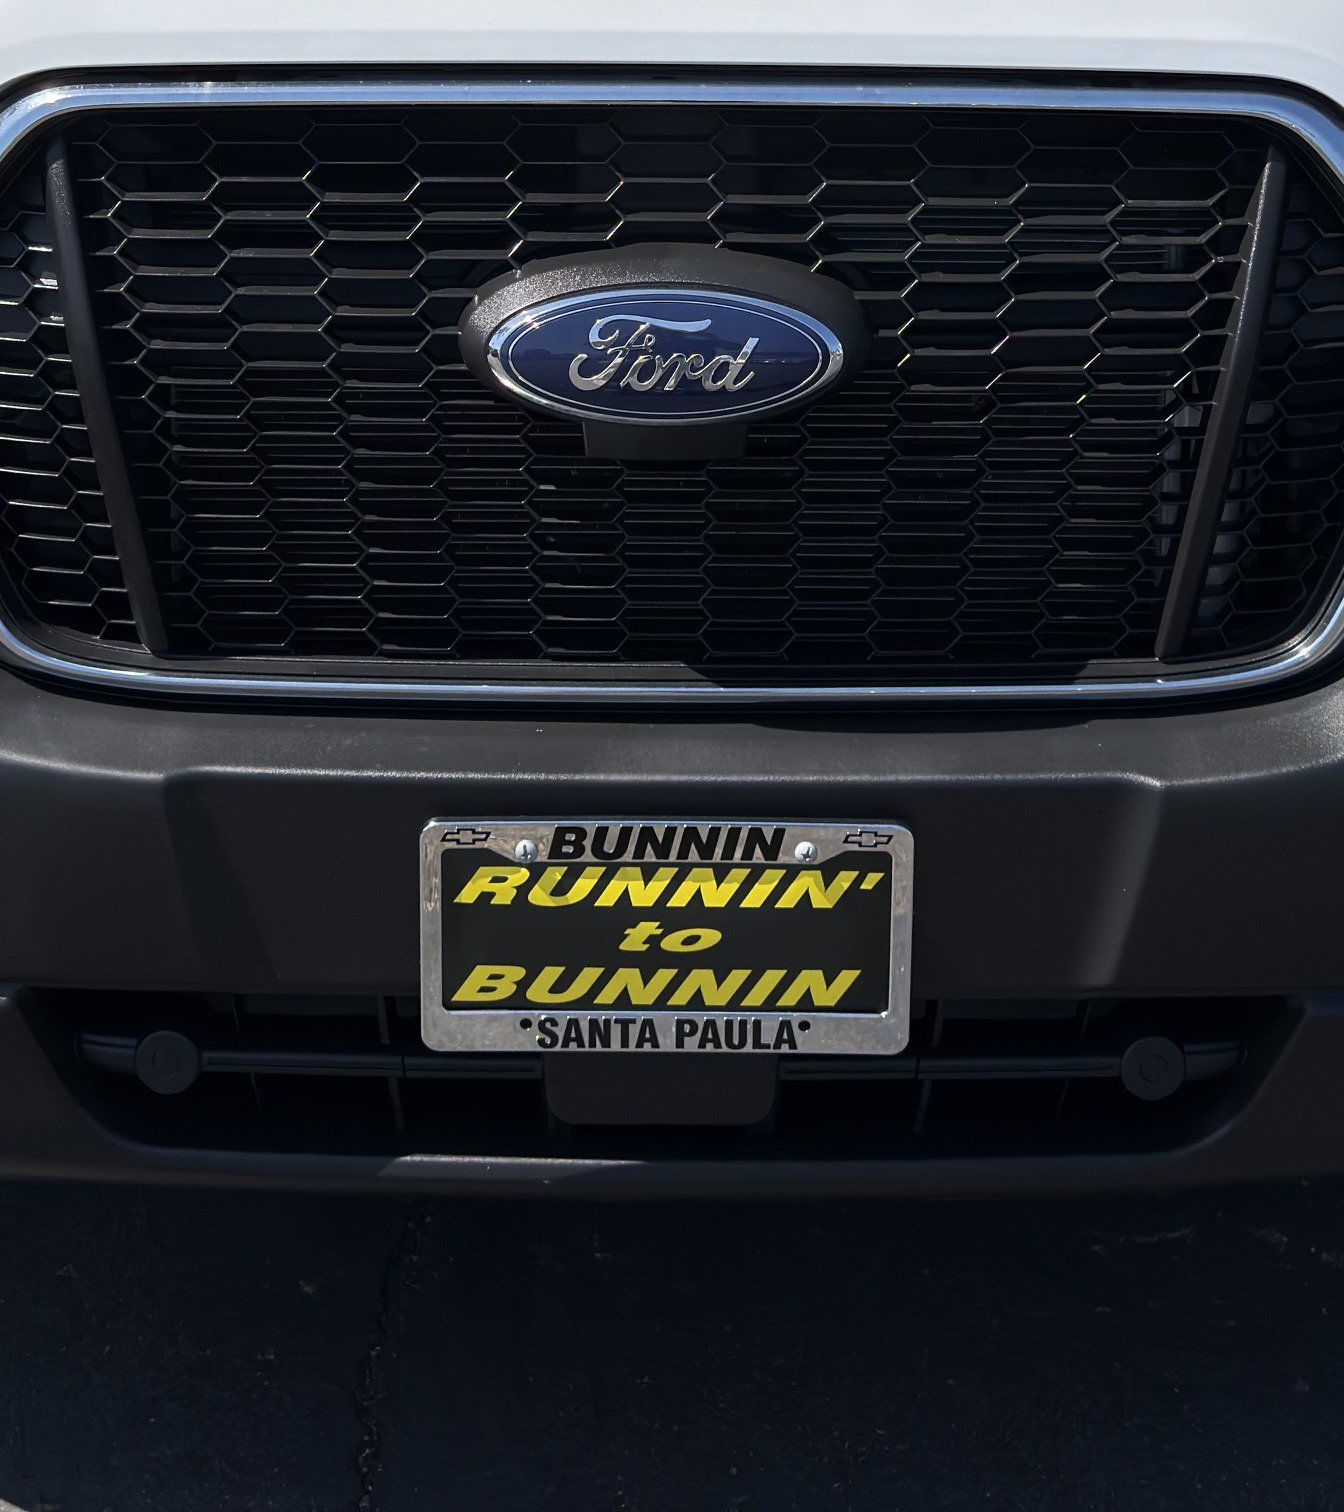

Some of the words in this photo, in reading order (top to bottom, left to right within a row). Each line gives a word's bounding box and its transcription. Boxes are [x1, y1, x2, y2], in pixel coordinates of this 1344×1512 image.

[568, 314, 760, 392] Ford
[547, 826, 787, 862] BUNNIN
[453, 866, 886, 909] RUNNIN'
[618, 921, 723, 953] to
[451, 964, 862, 1008] BUNNIN
[536, 1016, 659, 1050] SANTA
[674, 1017, 799, 1051] PAULA
